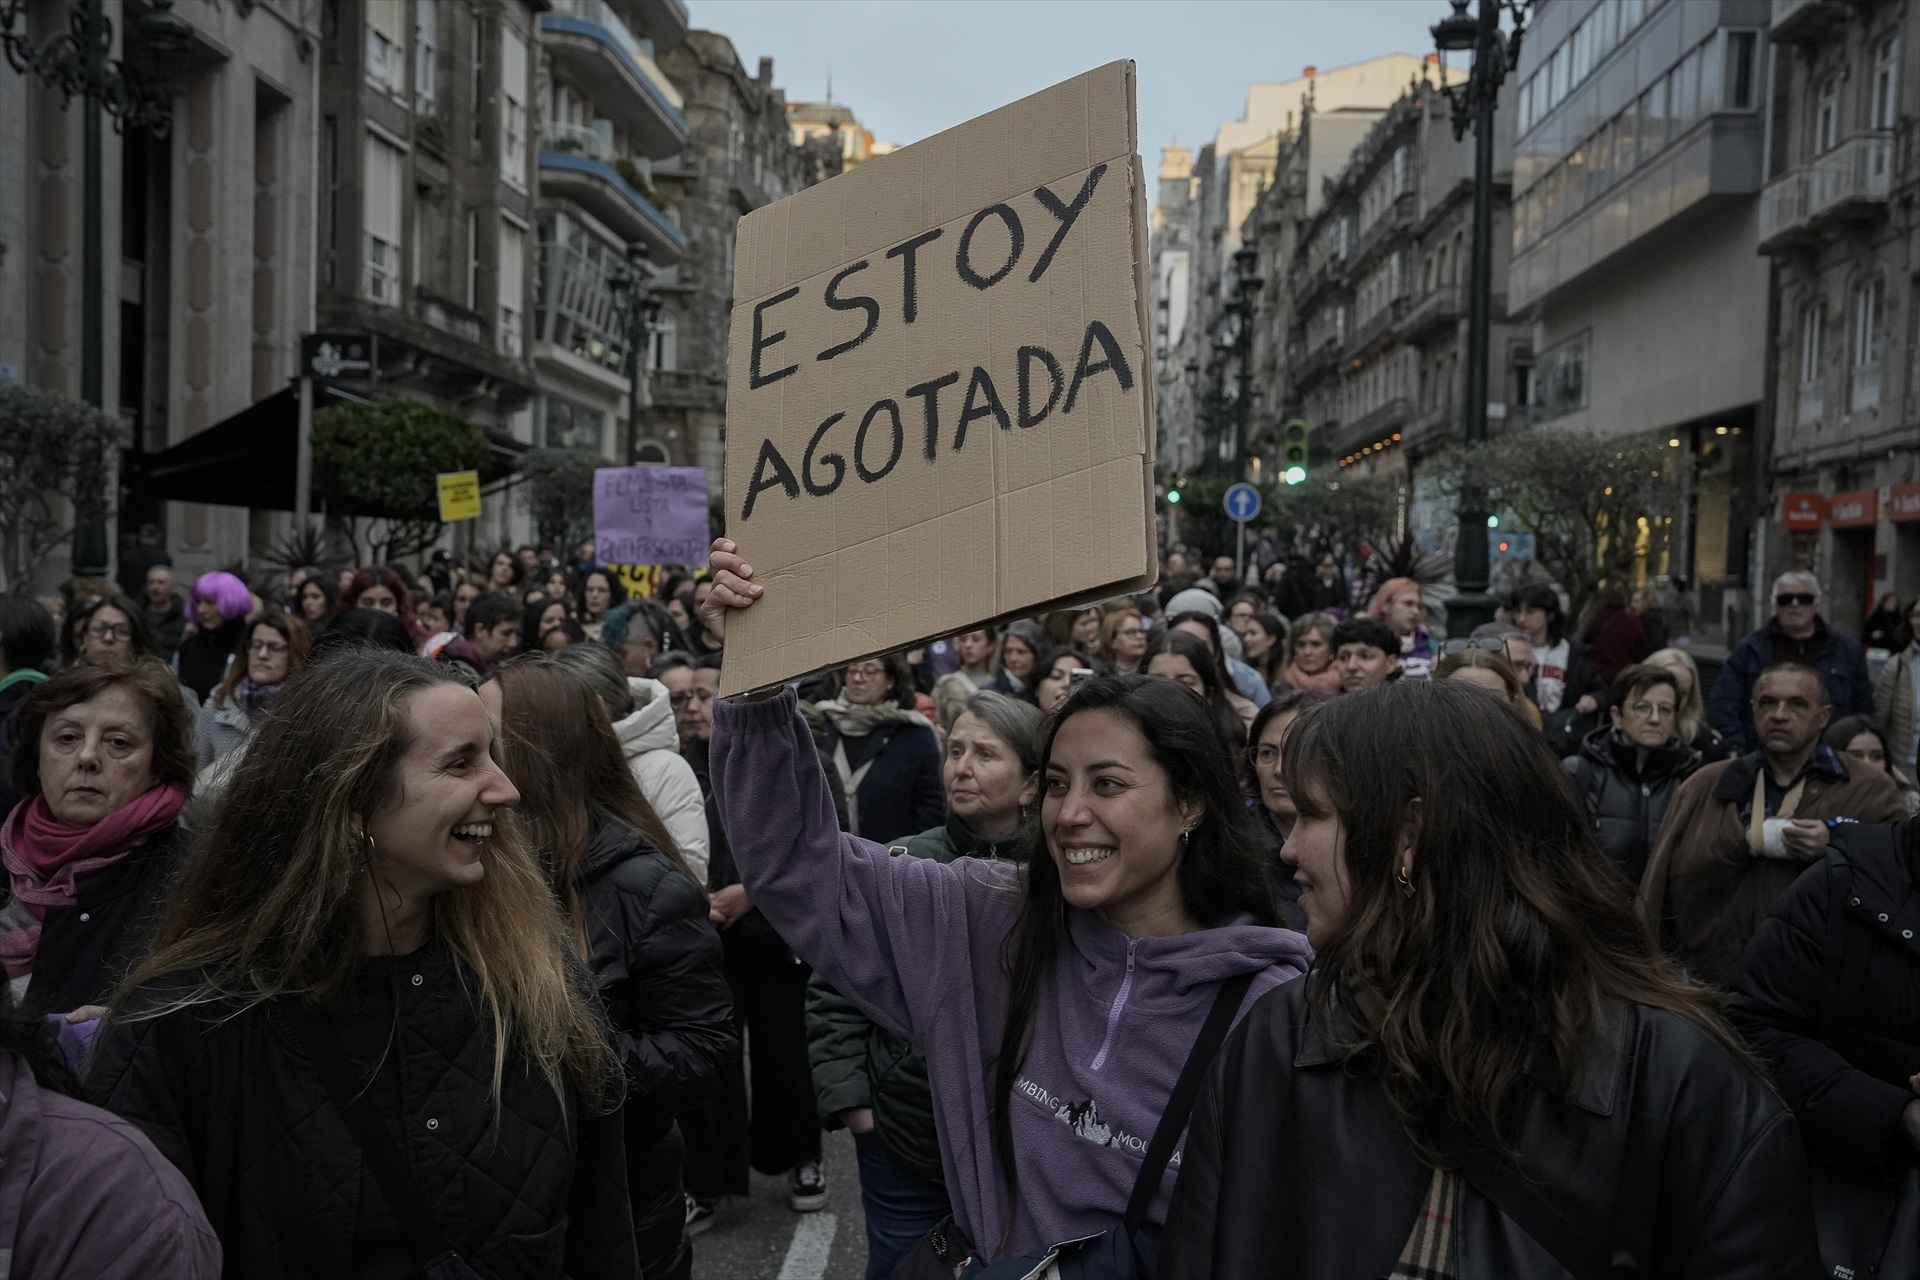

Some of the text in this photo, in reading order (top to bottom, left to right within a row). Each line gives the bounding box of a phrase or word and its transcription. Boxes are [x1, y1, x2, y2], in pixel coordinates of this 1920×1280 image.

[749, 163, 1108, 391] ESTOY
[741, 319, 1135, 522] AGOTADA
[1015, 1075, 1060, 1110] MBING
